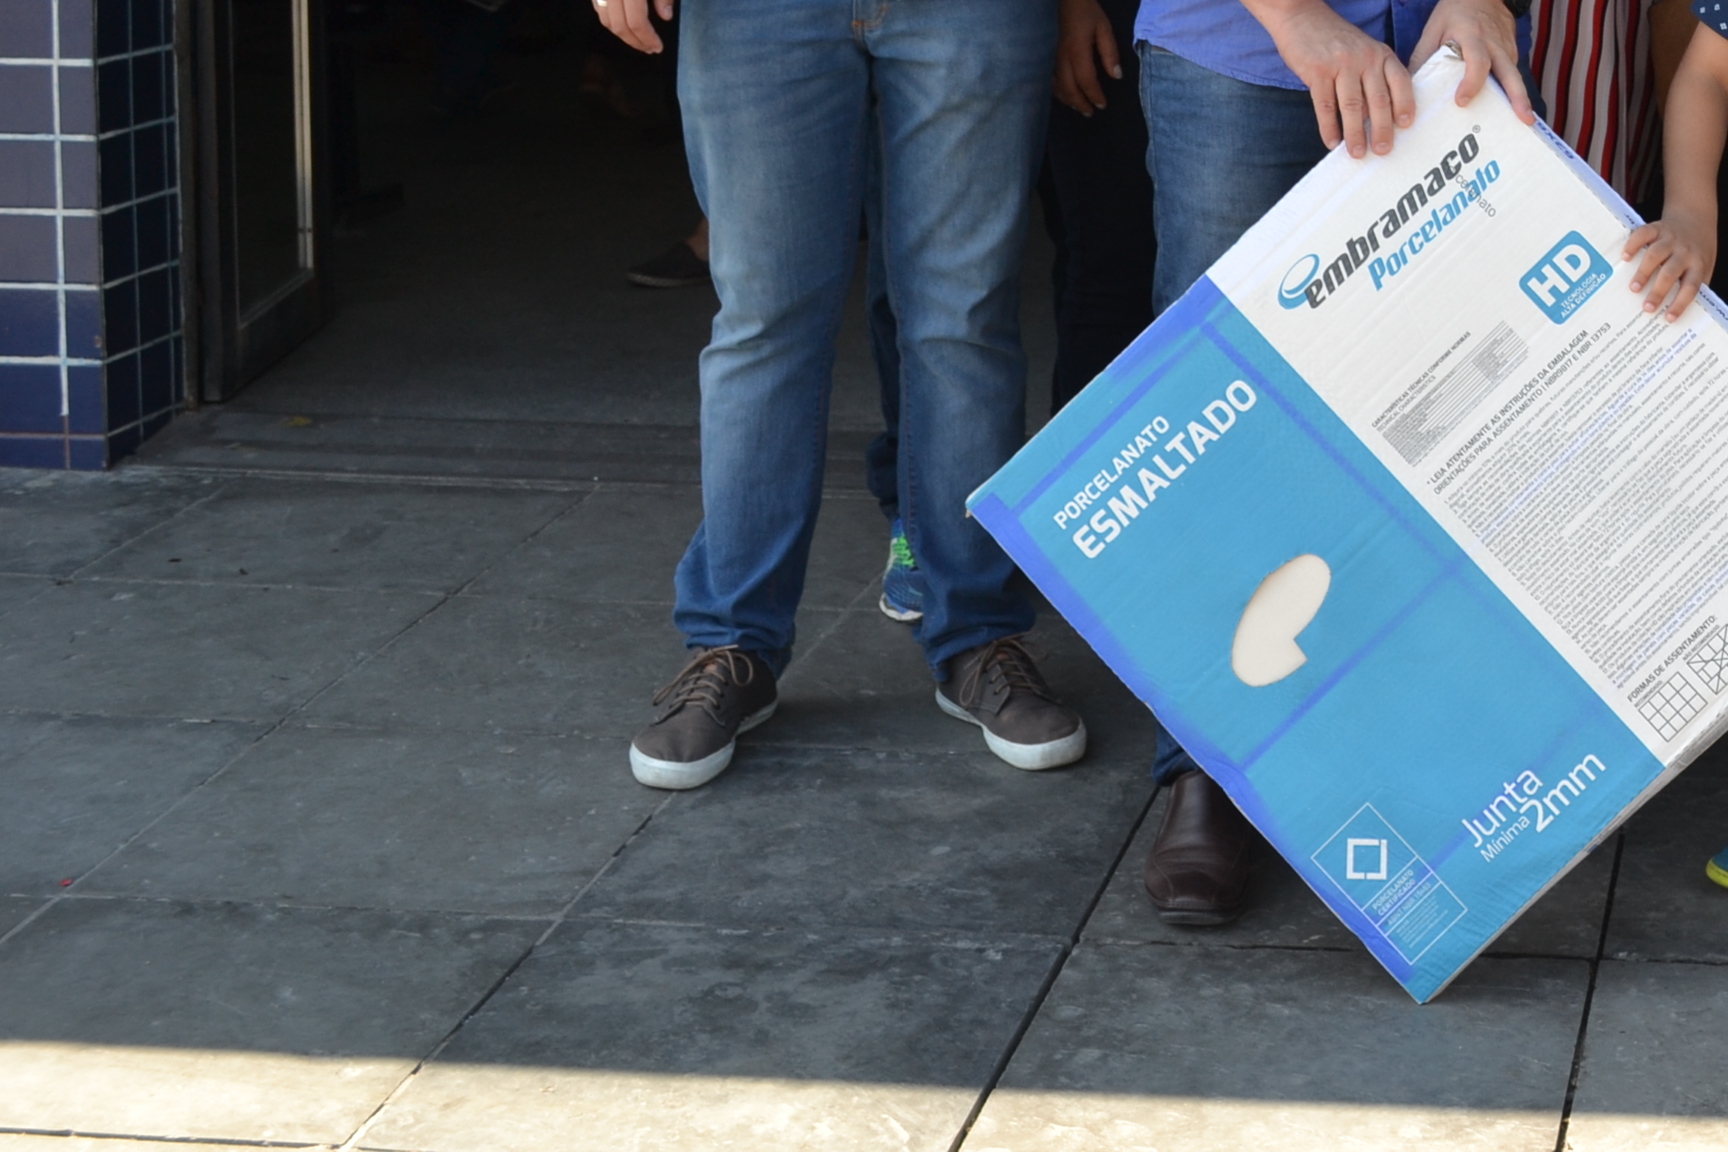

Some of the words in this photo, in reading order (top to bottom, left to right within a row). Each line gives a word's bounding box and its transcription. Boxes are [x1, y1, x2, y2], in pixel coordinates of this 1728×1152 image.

[1302, 132, 1480, 309] embramaco
[1366, 159, 1500, 292] Porcelanato
[1526, 243, 1591, 307] HD
[1559, 272, 1599, 308] TECNOLOGIA
[1560, 302, 1577, 318] ALTA
[1429, 466, 1447, 484] LEIA
[1444, 422, 1492, 469] ATENTAMENTE
[1489, 413, 1501, 426] AS
[1497, 376, 1540, 417] INSTRUÇÕES
[1536, 367, 1550, 380] DA
[1546, 328, 1589, 371] EMBALAGEM
[1432, 451, 1477, 495] ORIENTAÇÕES
[1472, 436, 1494, 456] PARA
[1491, 387, 1543, 439] ASSENTAMENTO
[1543, 357, 1573, 388] NBR9817
[1575, 339, 1593, 356] NBR
[1589, 321, 1611, 342] 13753
[1052, 415, 1170, 530] PORCELANATO
[1071, 378, 1257, 559] ESMALTADO
[1626, 672, 1656, 703] FORMAS
[1652, 663, 1665, 677] DE
[1662, 614, 1716, 668] ASSENTAMENTO:
[1460, 769, 1544, 848] Junta
[1479, 811, 1531, 863] Mínima
[1518, 753, 1606, 833] 2mm
[1371, 868, 1414, 910] PORCELANATO
[1376, 877, 1416, 916] CERTIFICADO
